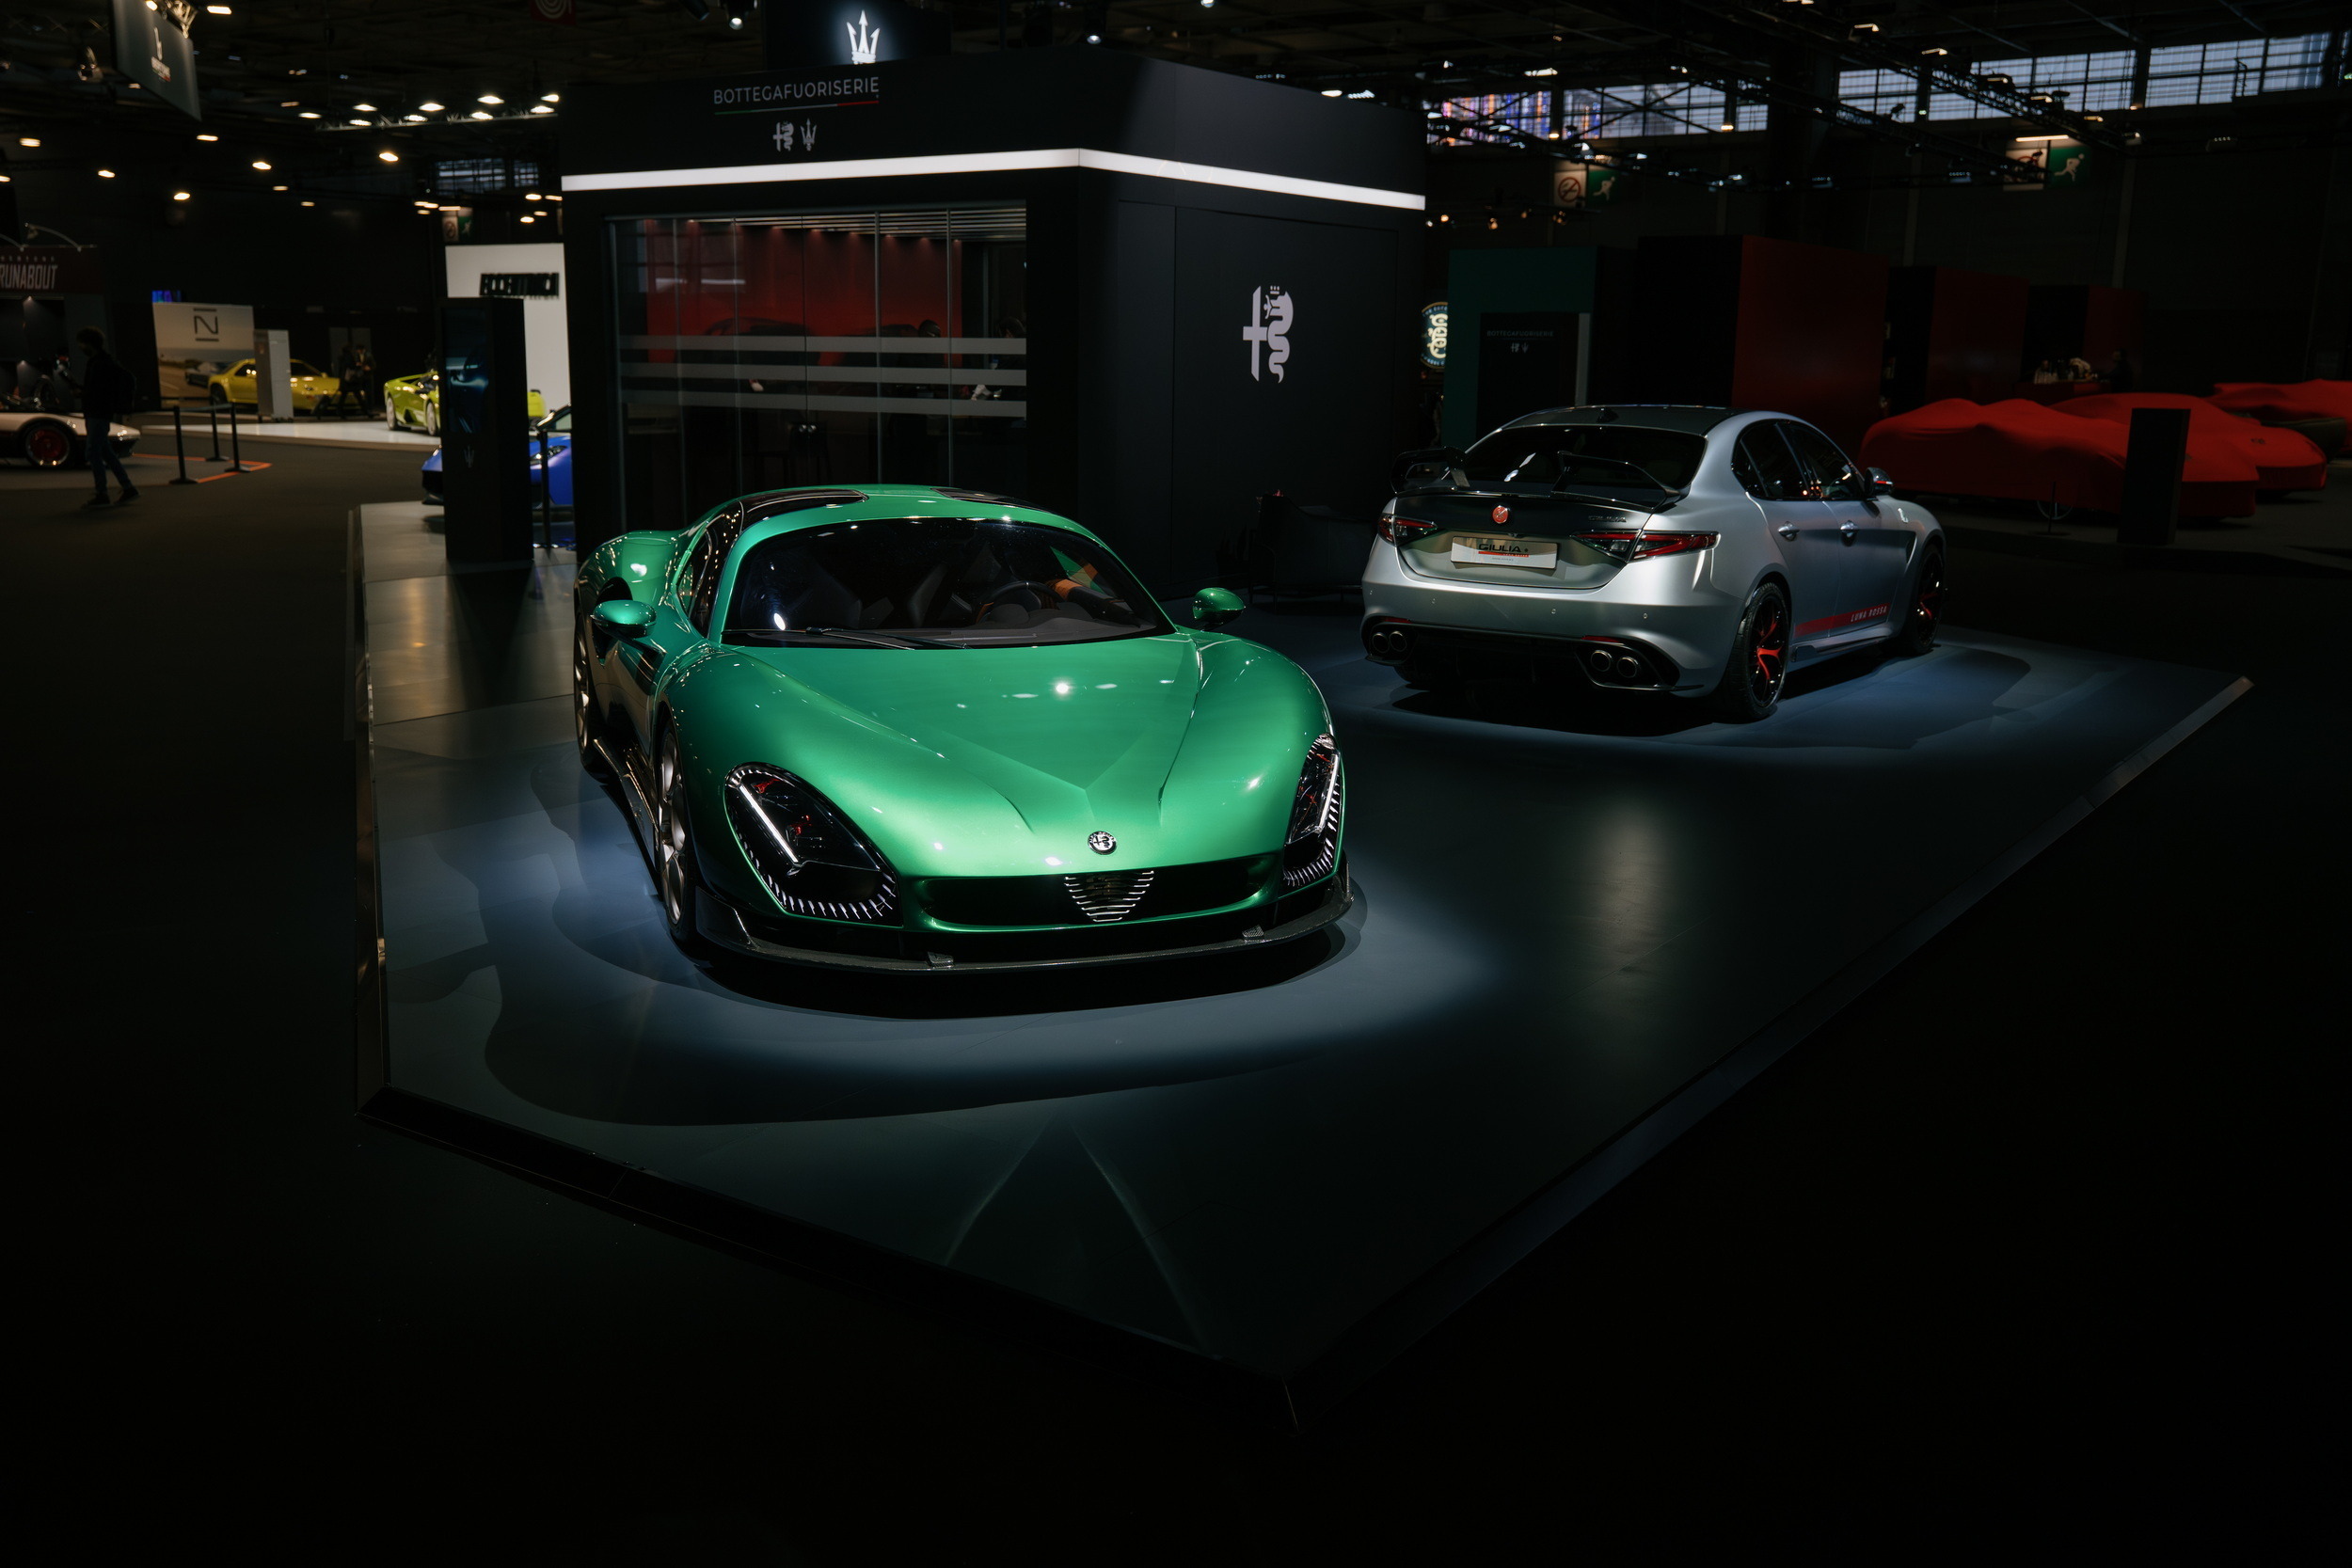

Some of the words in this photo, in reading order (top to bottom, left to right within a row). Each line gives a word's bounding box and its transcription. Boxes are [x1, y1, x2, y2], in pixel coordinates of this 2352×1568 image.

[713, 76, 880, 104] BOTTEGAFUORISERIE
[0, 263, 58, 290] RUNABOUT
[1478, 544, 1522, 553] GIULIA
[1868, 606, 1886, 616] ROSSA
